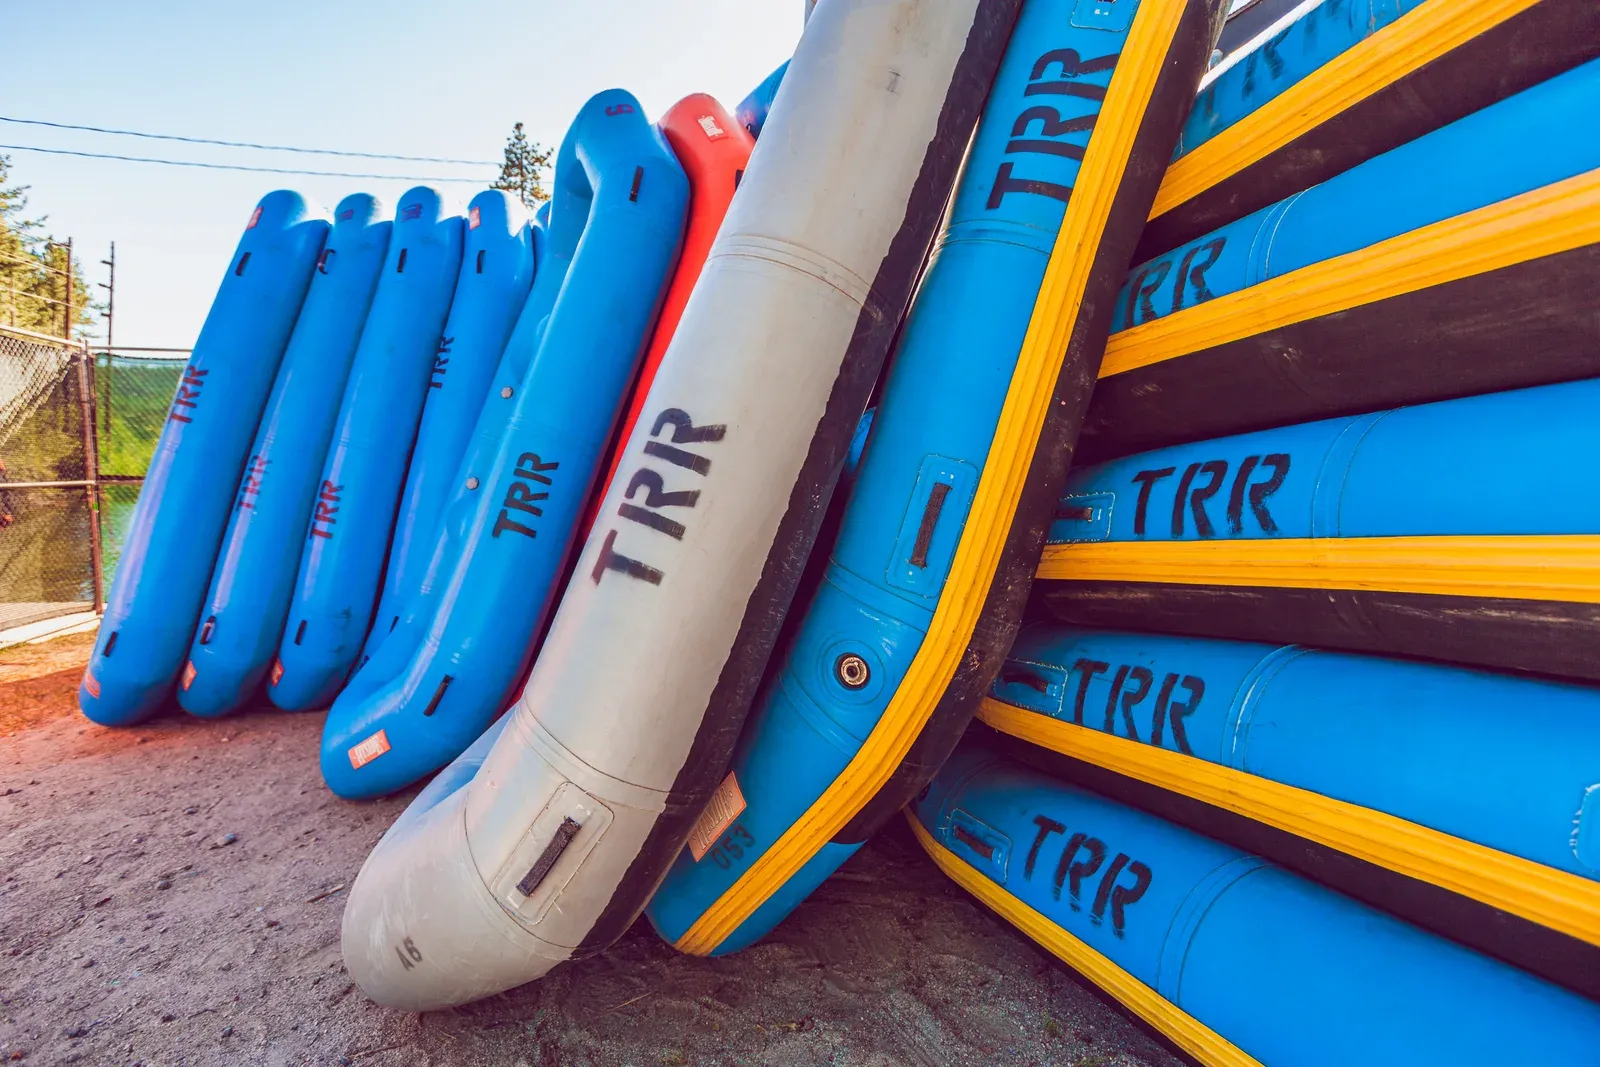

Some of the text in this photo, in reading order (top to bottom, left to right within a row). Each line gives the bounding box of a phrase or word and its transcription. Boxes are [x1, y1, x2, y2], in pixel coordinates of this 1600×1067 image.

[985, 48, 1120, 210] TRR
[1122, 236, 1228, 330] RR
[168, 365, 209, 424] TRR
[236, 454, 272, 511] TRR
[309, 480, 344, 540] TRR
[492, 452, 560, 538] TRR
[591, 408, 727, 586] TRR
[1131, 453, 1291, 538] TRR
[1073, 657, 1206, 757] TRR
[1024, 814, 1153, 940] TRR
